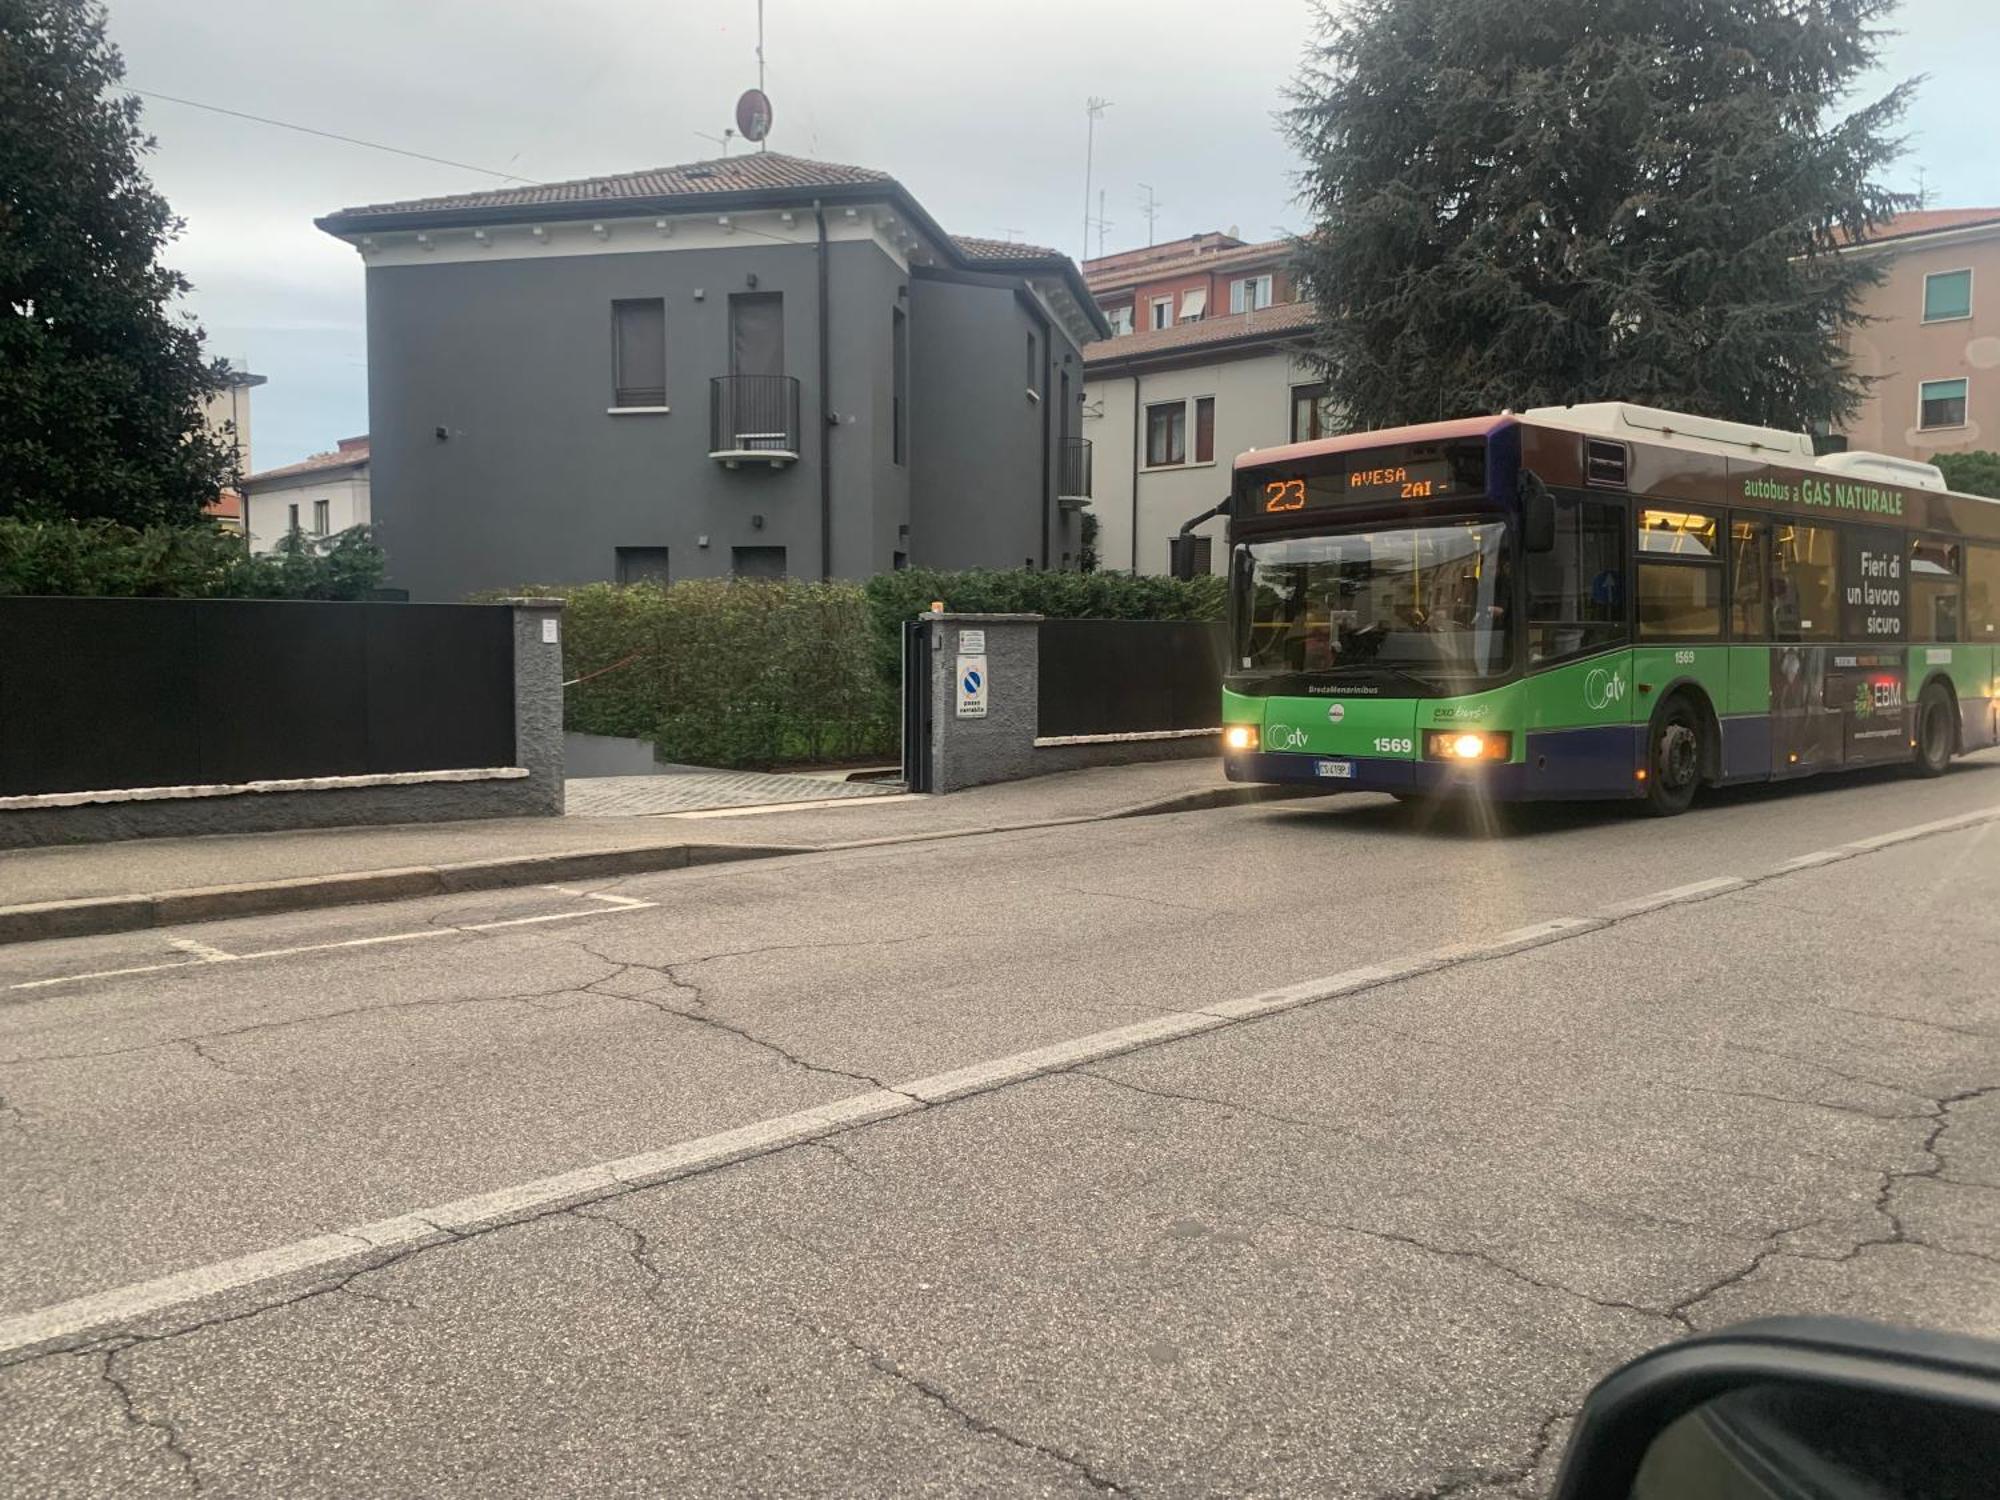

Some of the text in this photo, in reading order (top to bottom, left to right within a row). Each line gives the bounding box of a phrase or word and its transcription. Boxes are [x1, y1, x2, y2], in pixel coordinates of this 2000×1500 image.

[1351, 467, 1406, 487] AVESA
[1400, 481, 1432, 498] ZAI
[1265, 479, 1306, 512] 23
[1744, 479, 1903, 515] autobus a GAS NATURALE
[1861, 551, 1900, 578] Fieri di
[1847, 580, 1900, 606] un lavoro
[1867, 609, 1900, 634] sicuro
[1675, 650, 1695, 664] 1569
[1606, 671, 1625, 701] atv
[1874, 682, 1901, 707] EBM
[1288, 727, 1309, 747] atv
[1373, 738, 1413, 753] 1569
